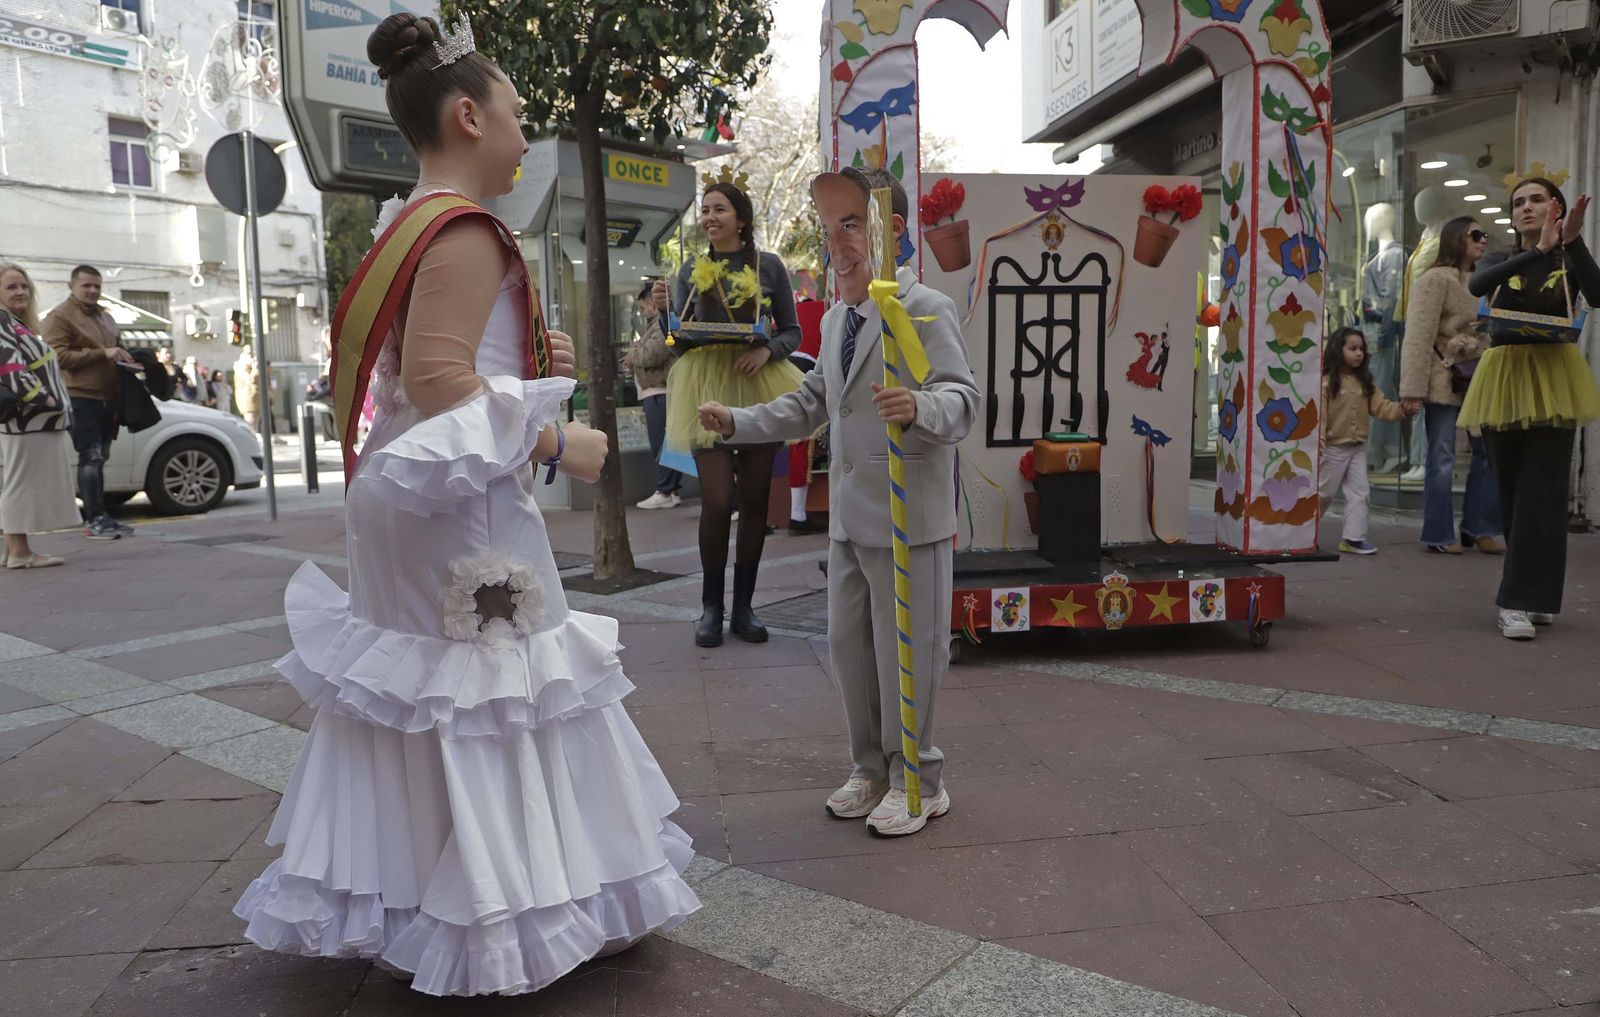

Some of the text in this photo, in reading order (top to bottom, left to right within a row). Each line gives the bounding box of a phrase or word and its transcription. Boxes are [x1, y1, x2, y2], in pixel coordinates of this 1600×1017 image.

[309, 0, 362, 23] HIPERCOR
[326, 62, 366, 84] BAHÍA
[1045, 80, 1088, 121] ASESORES
[1172, 131, 1214, 164] Martino
[615, 160, 663, 183] ONCE
